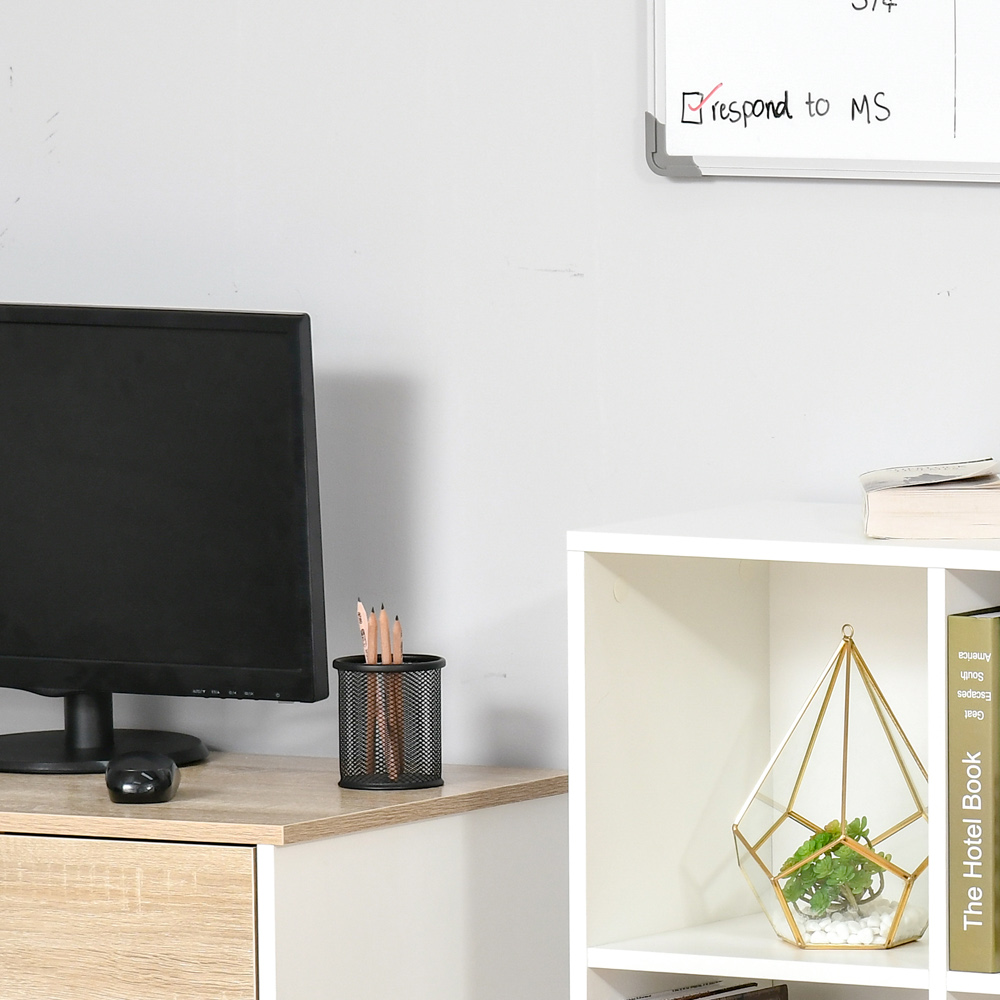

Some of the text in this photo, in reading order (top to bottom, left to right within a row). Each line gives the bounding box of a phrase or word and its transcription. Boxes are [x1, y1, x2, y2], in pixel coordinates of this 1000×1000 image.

[712, 90, 891, 128] respond to MS
[958, 651, 991, 662] America
[960, 671, 984, 681] South
[957, 689, 991, 701] Escapes
[961, 751, 983, 931] The Hotel Book
